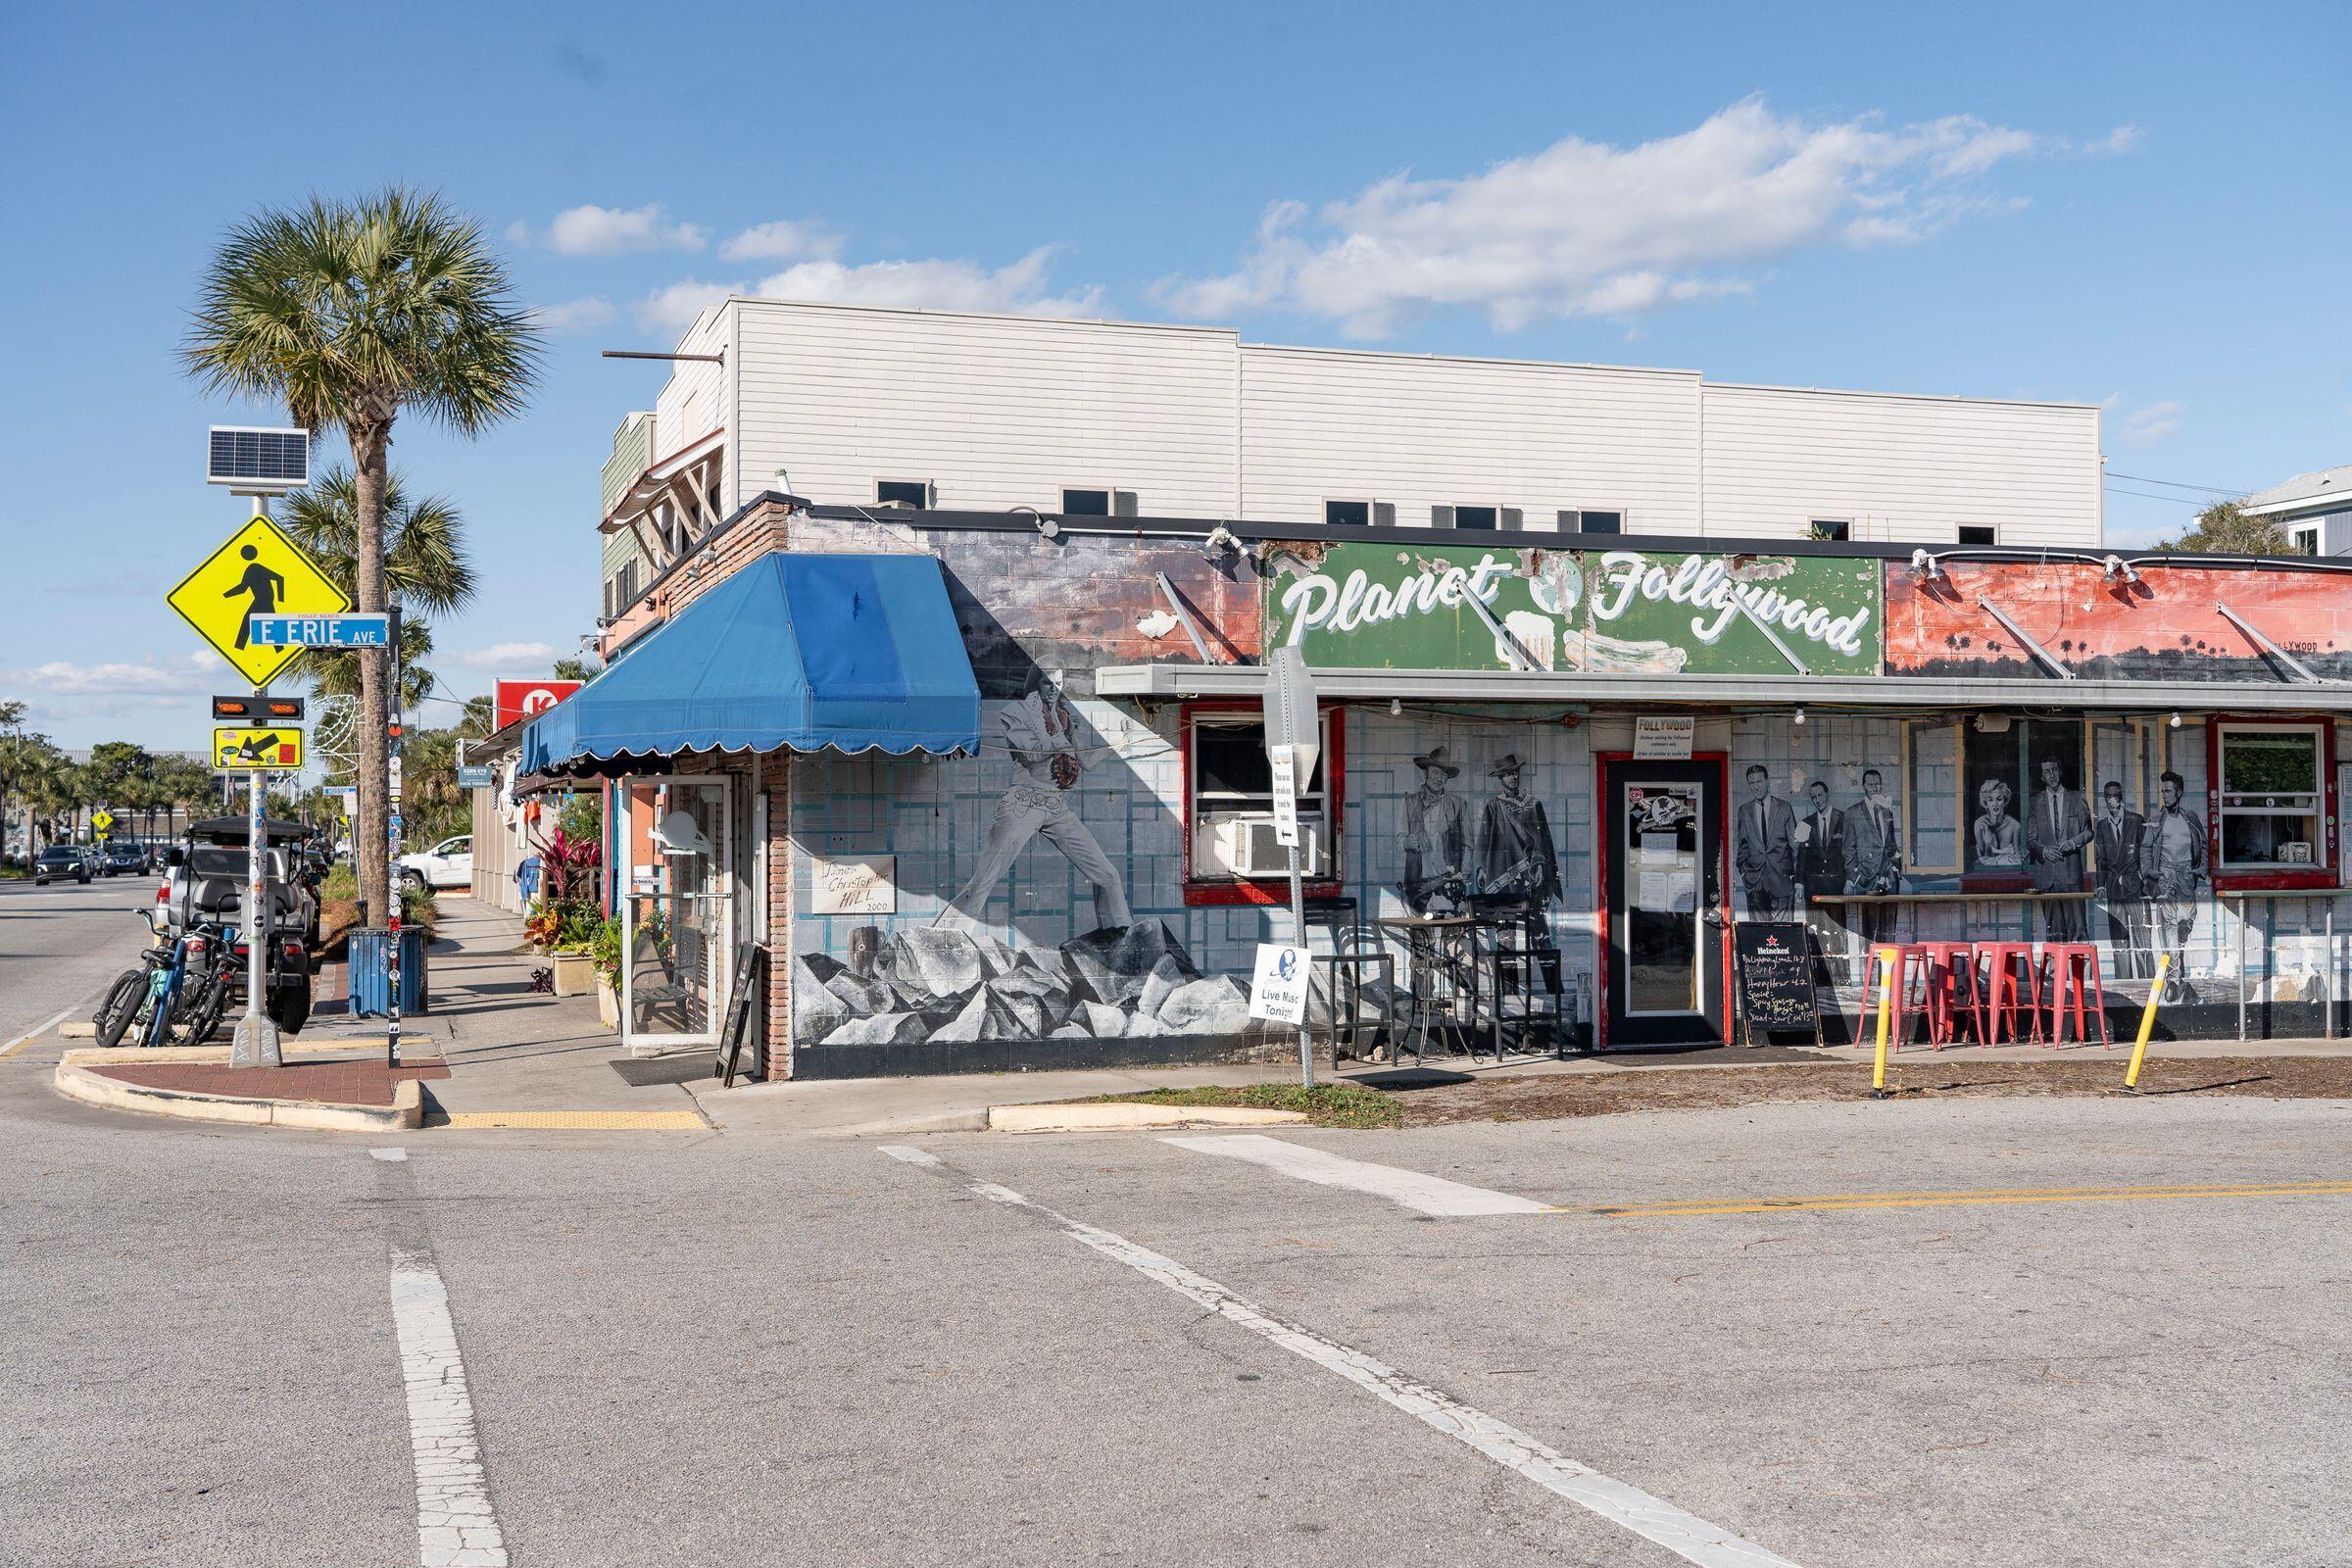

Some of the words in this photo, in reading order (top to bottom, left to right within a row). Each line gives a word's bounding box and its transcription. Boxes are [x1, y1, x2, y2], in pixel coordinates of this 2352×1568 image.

[1282, 554, 1513, 647] Planet
[1593, 552, 1870, 653] Follywood
[261, 620, 274, 644] E
[287, 620, 343, 644] ERIE
[353, 631, 376, 643] AVE
[2274, 641, 2318, 651] LLYWOOD
[1639, 719, 1692, 731] FOLLYWOOD
[867, 903, 888, 911] 2000
[1262, 989, 1280, 1001] Live
